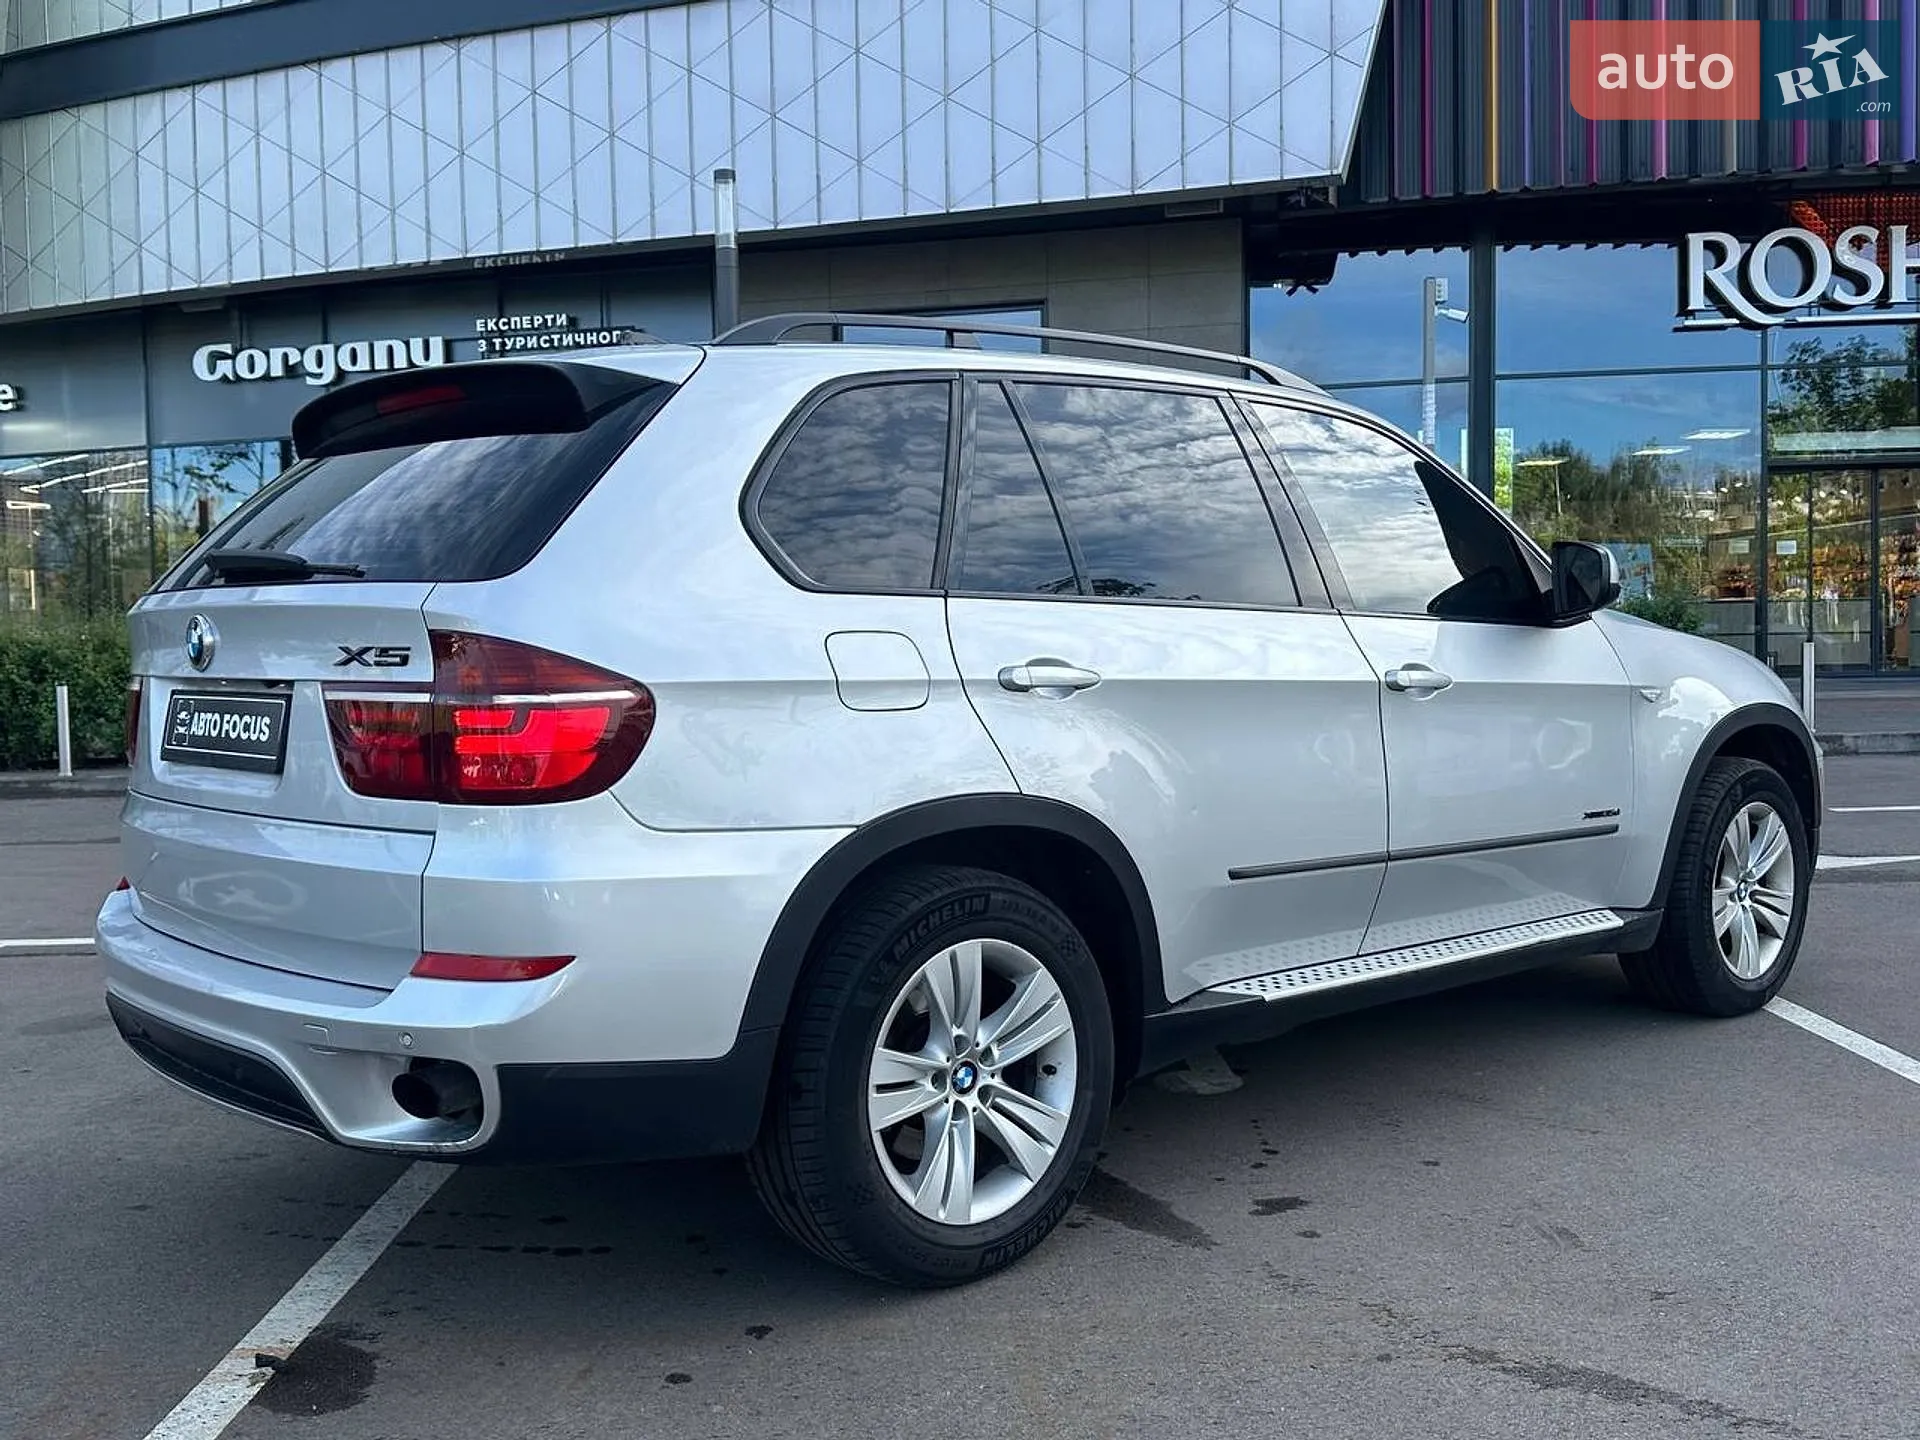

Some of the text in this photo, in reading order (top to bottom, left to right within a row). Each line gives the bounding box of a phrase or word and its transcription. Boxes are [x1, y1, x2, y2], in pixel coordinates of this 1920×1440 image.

[475, 313, 567, 332] ЕКСПЕРТИ
[333, 646, 412, 667] X5
[221, 714, 271, 742] FOCUS
[892, 895, 986, 962] MICHELIN
